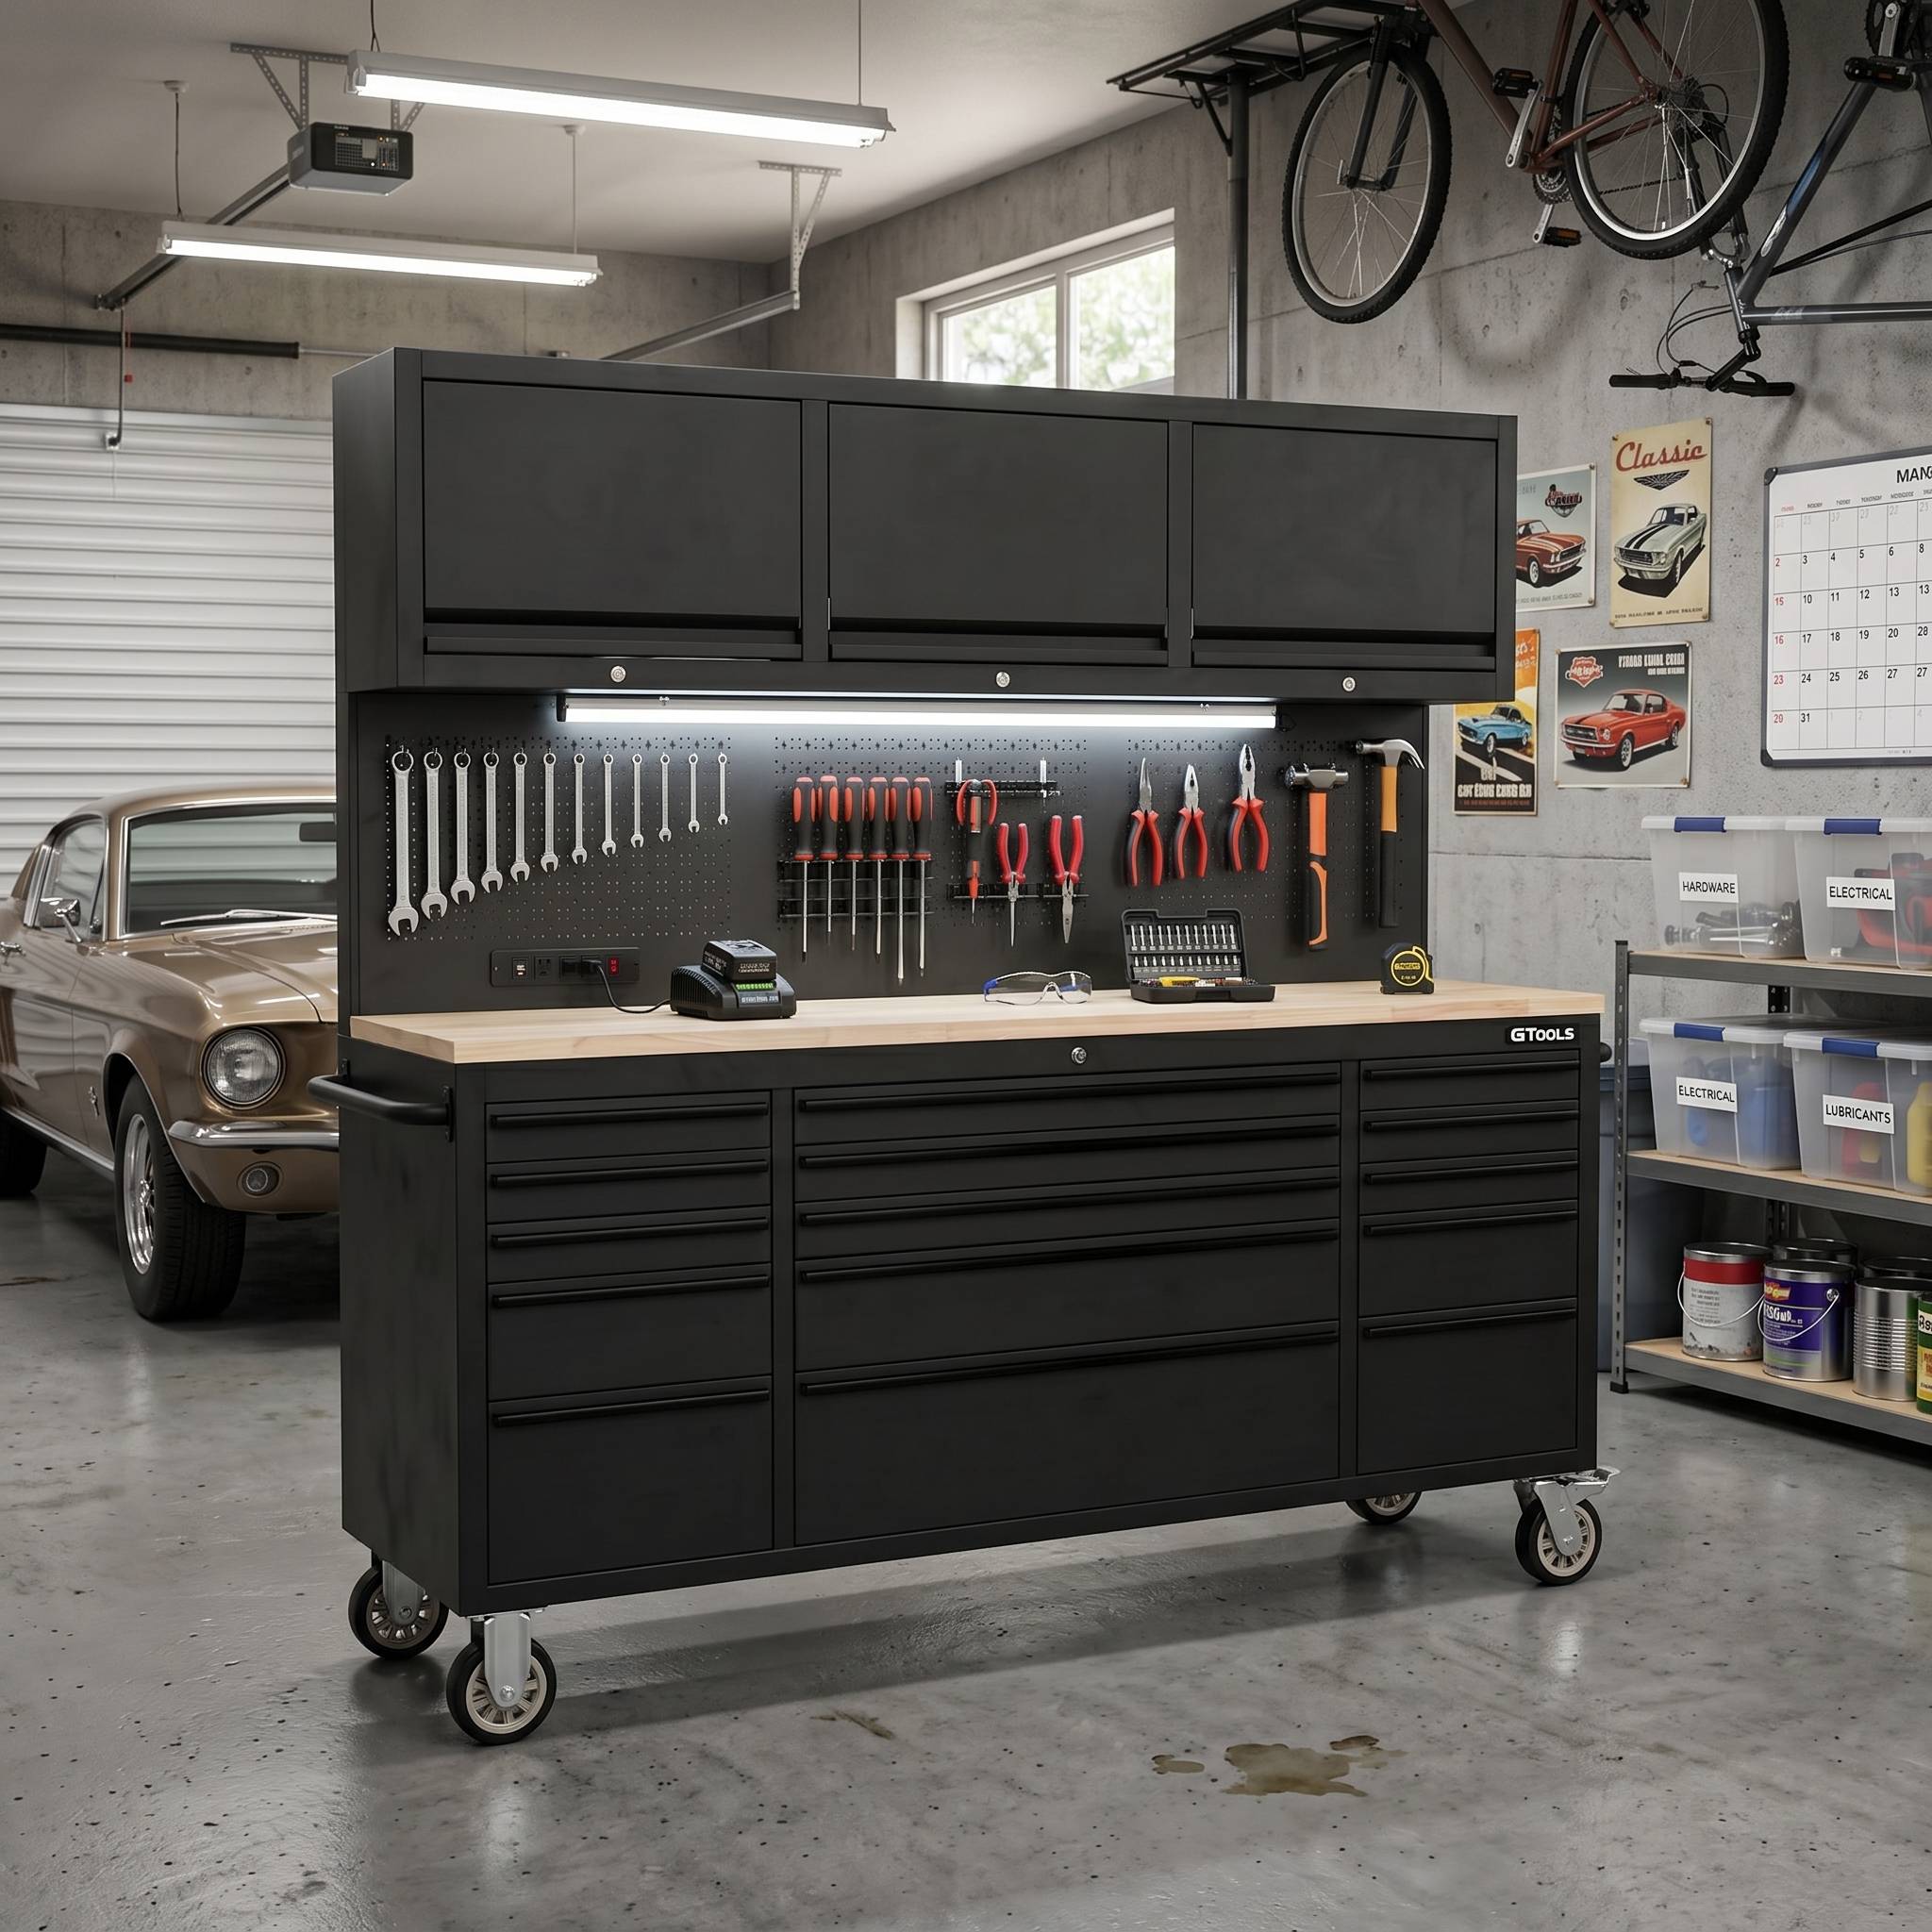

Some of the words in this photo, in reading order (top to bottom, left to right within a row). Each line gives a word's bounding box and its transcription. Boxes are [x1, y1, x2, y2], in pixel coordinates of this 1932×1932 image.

[1615, 438, 1708, 473] Classic
[1774, 558, 1781, 567] 2
[1802, 555, 1808, 565] 3
[1830, 552, 1837, 562] 4
[1858, 548, 1865, 559] 5
[1889, 545, 1895, 557] 6
[1919, 542, 1925, 554] 8
[1803, 593, 1813, 605] 10
[1830, 591, 1840, 602] 11
[1859, 589, 1871, 600] 12
[1889, 587, 1900, 597] 13
[1919, 584, 1930, 595] 13
[1774, 634, 1785, 645] 16
[1802, 633, 1812, 643] 17
[1830, 631, 1840, 641] 18
[1858, 629, 1870, 640] 19
[1888, 627, 1899, 639] 20
[1917, 625, 1928, 637] 28
[1774, 675, 1784, 685] 23
[1801, 673, 1812, 684] 24
[1829, 671, 1840, 682] 25
[1857, 670, 1869, 680] 26
[1887, 668, 1898, 679] 27
[1916, 666, 1928, 677] 27
[1800, 712, 1810, 724] 31
[1682, 881, 1736, 894] HARDWARE
[1829, 886, 1893, 900] ELECTRICAL
[1678, 1085, 1736, 1103] ELECTRICAL
[1825, 1104, 1891, 1124] LUBRICANTS
